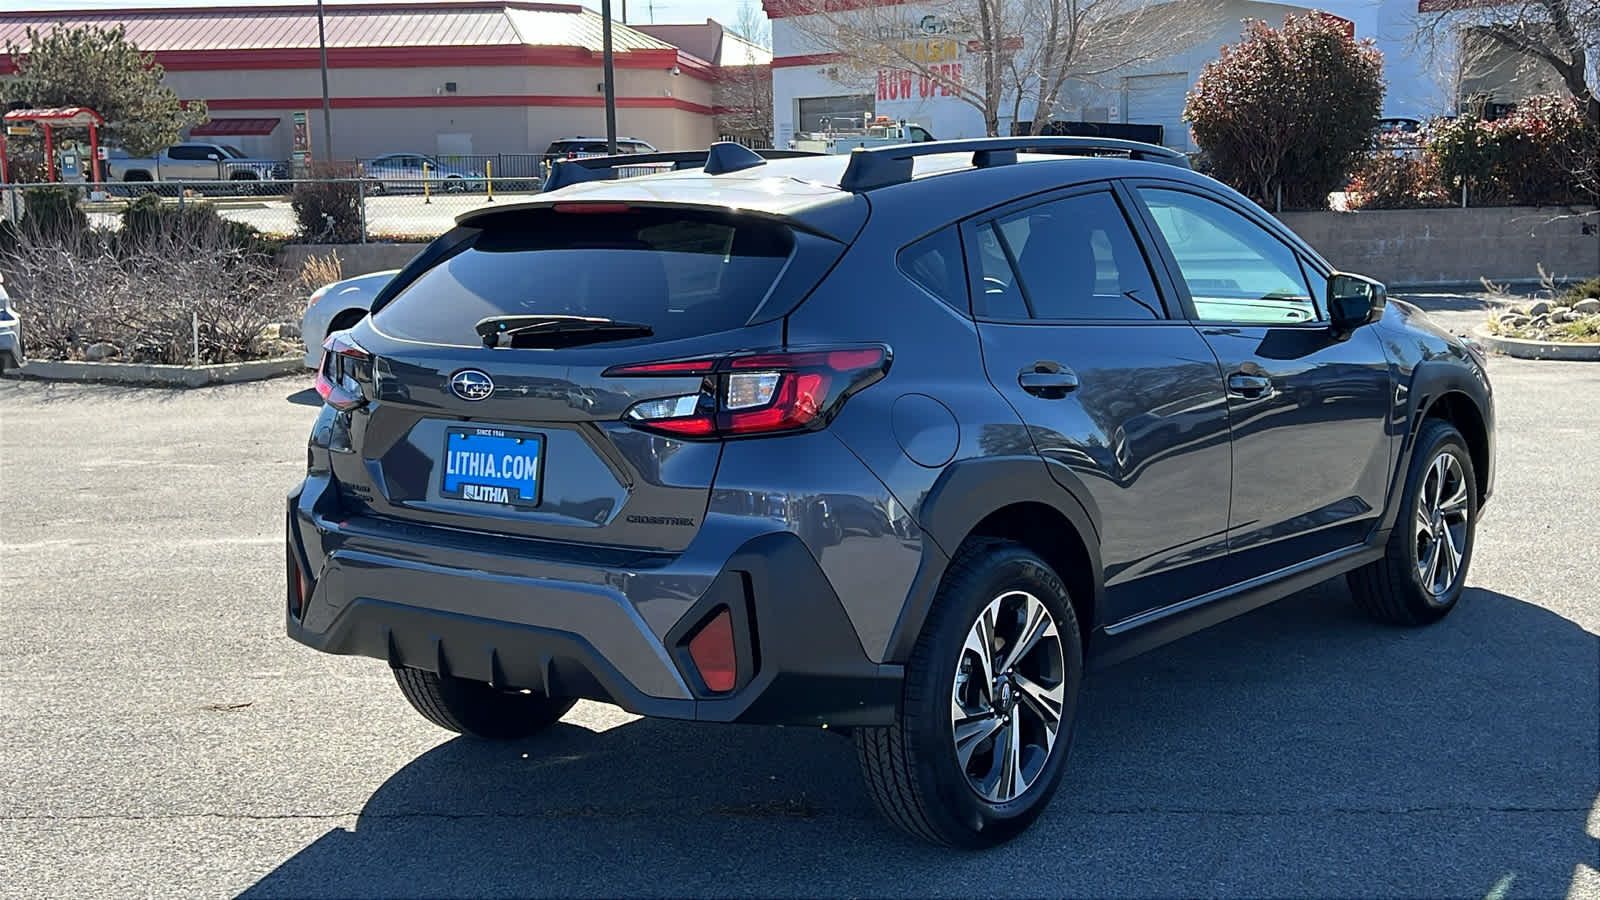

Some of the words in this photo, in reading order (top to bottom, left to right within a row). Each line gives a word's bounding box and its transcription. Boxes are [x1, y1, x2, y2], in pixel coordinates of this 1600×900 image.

[877, 69, 913, 101] NOW
[919, 63, 963, 98] OPEN
[476, 428, 492, 437] SINCE
[446, 450, 538, 481] LITHIA.COM
[474, 485, 509, 504] LITHIA
[626, 514, 695, 527] CROSSTREK
